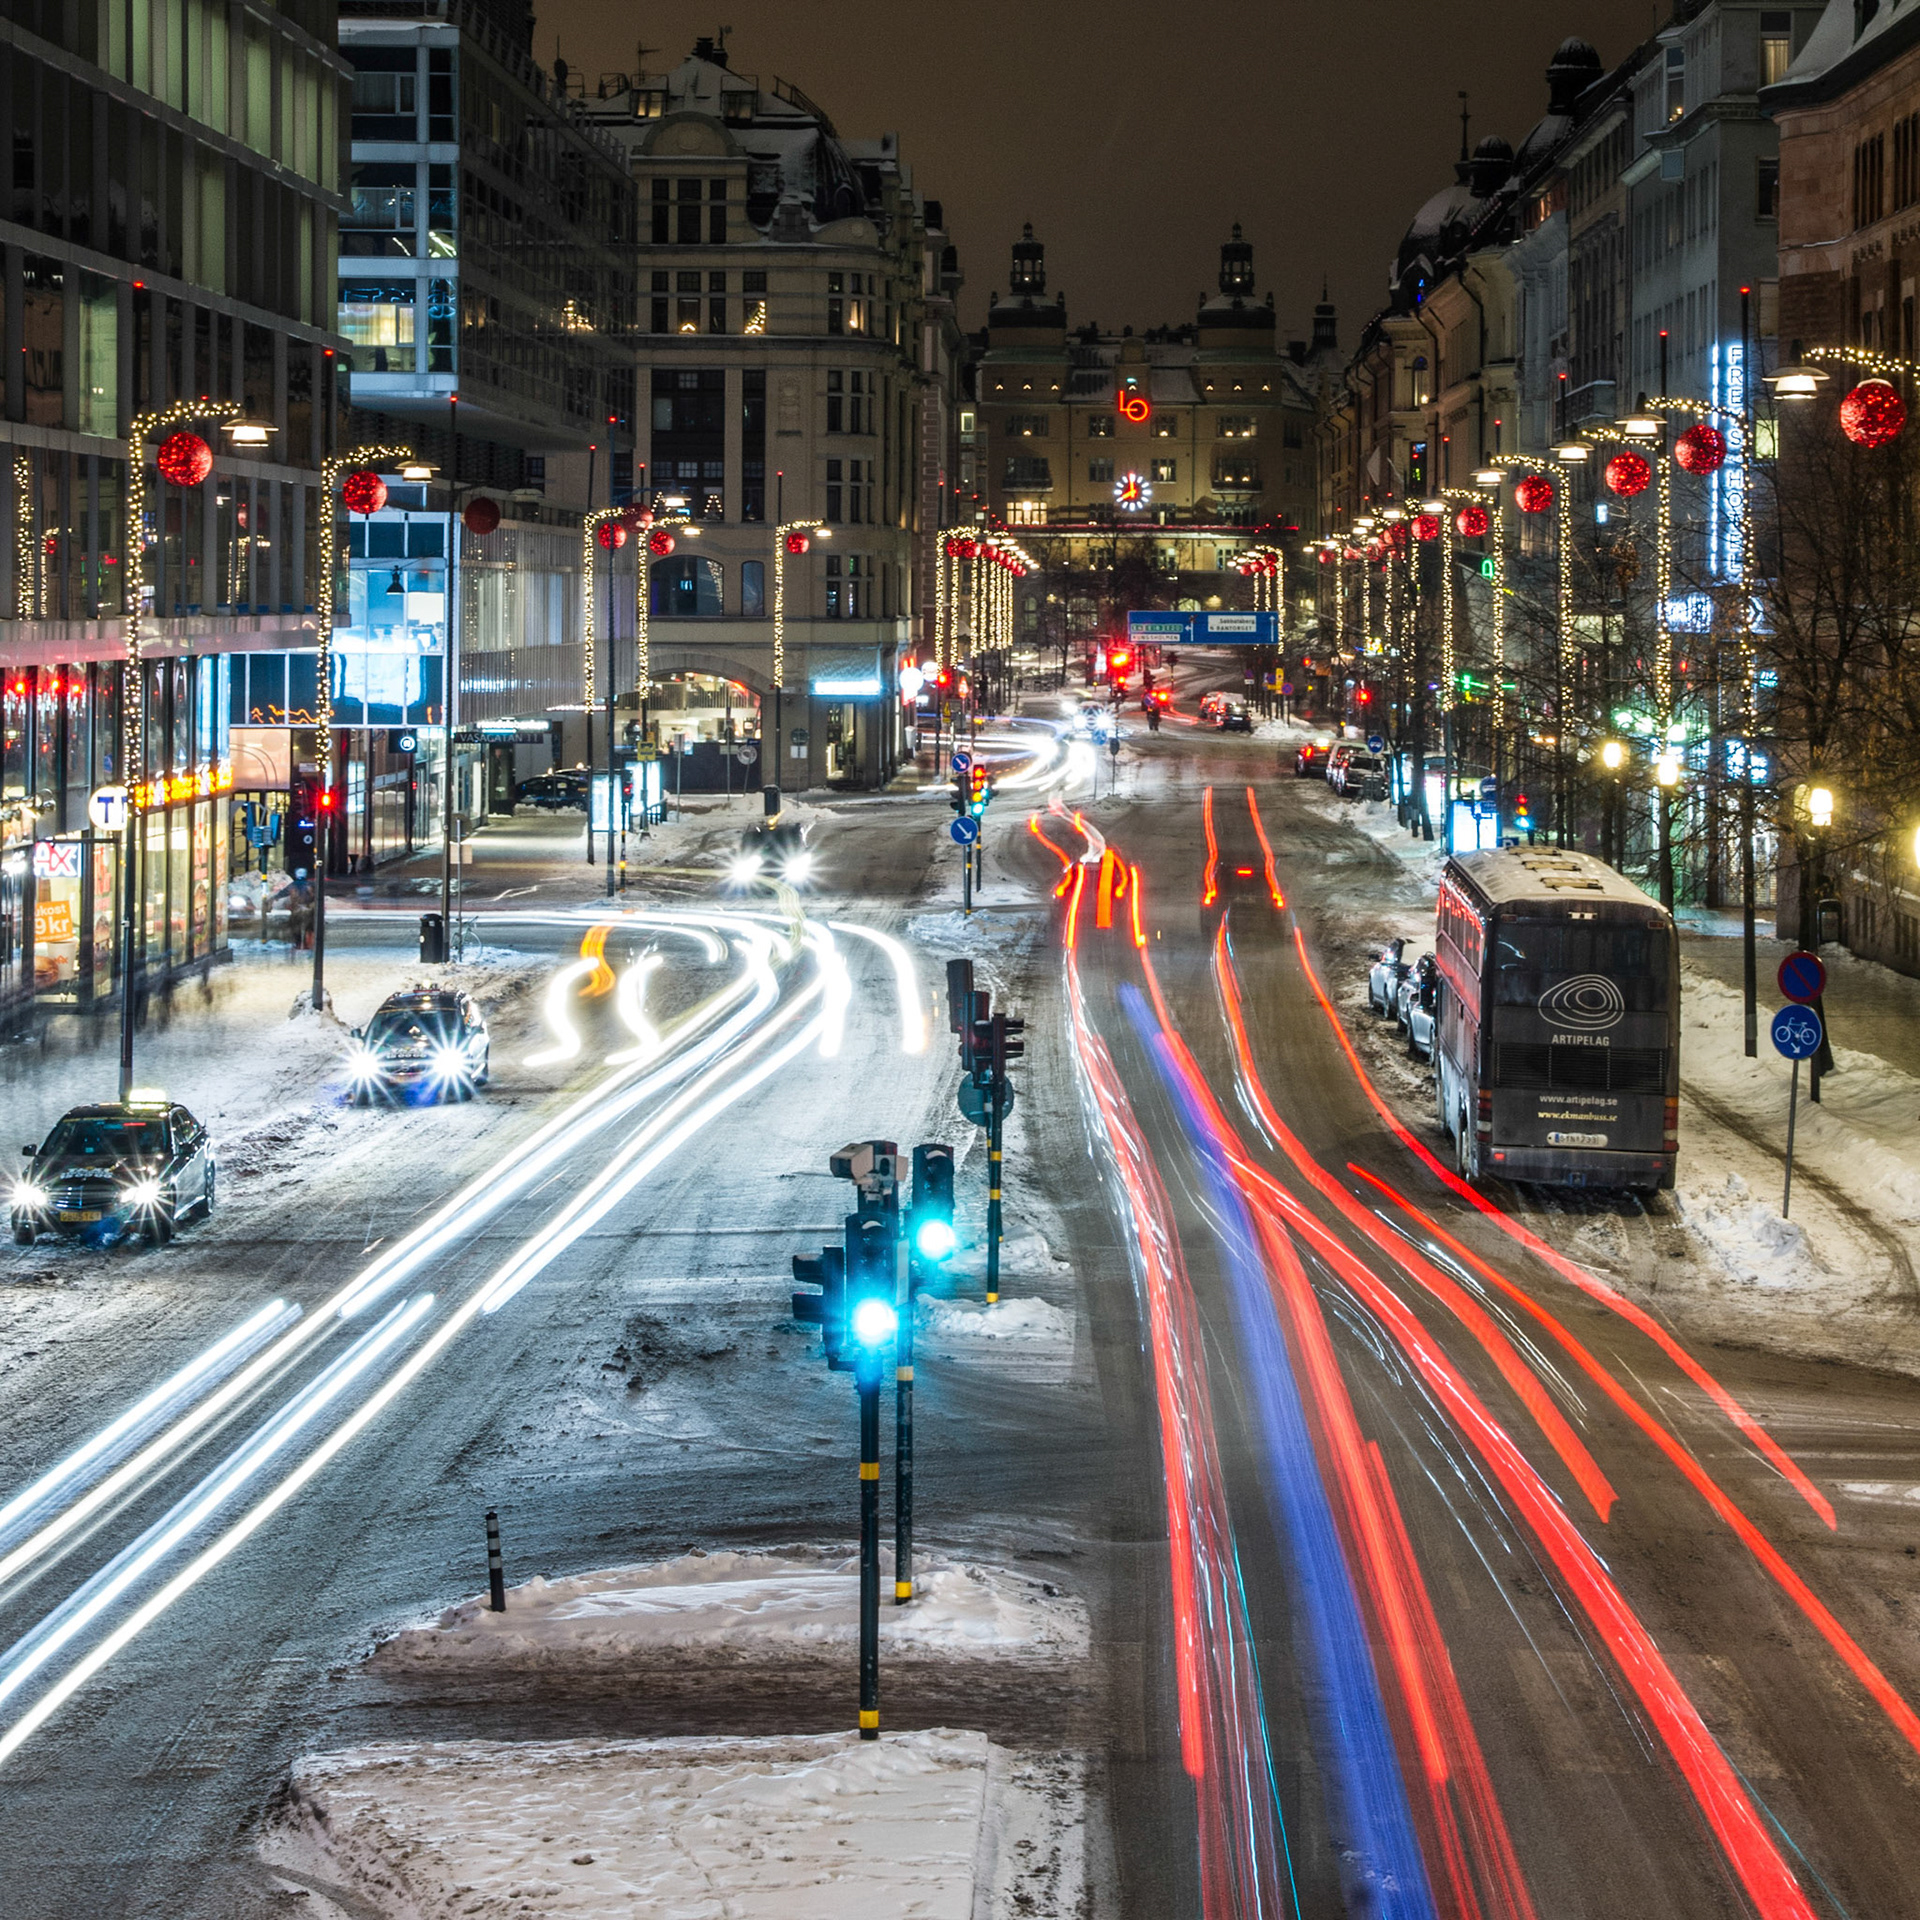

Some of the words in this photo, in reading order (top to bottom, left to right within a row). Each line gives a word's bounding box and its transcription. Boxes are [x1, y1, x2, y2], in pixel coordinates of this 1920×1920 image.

[460, 733, 523, 742] VASAGATAN
[97, 796, 115, 824] T
[35, 903, 67, 916] ukost
[49, 916, 70, 934] kr
[1551, 1034, 1610, 1046] ARTIPELAG
[1539, 1095, 1618, 1107] www.artipelag.se
[1537, 1111, 1618, 1122] www.ekmanbuss.se
